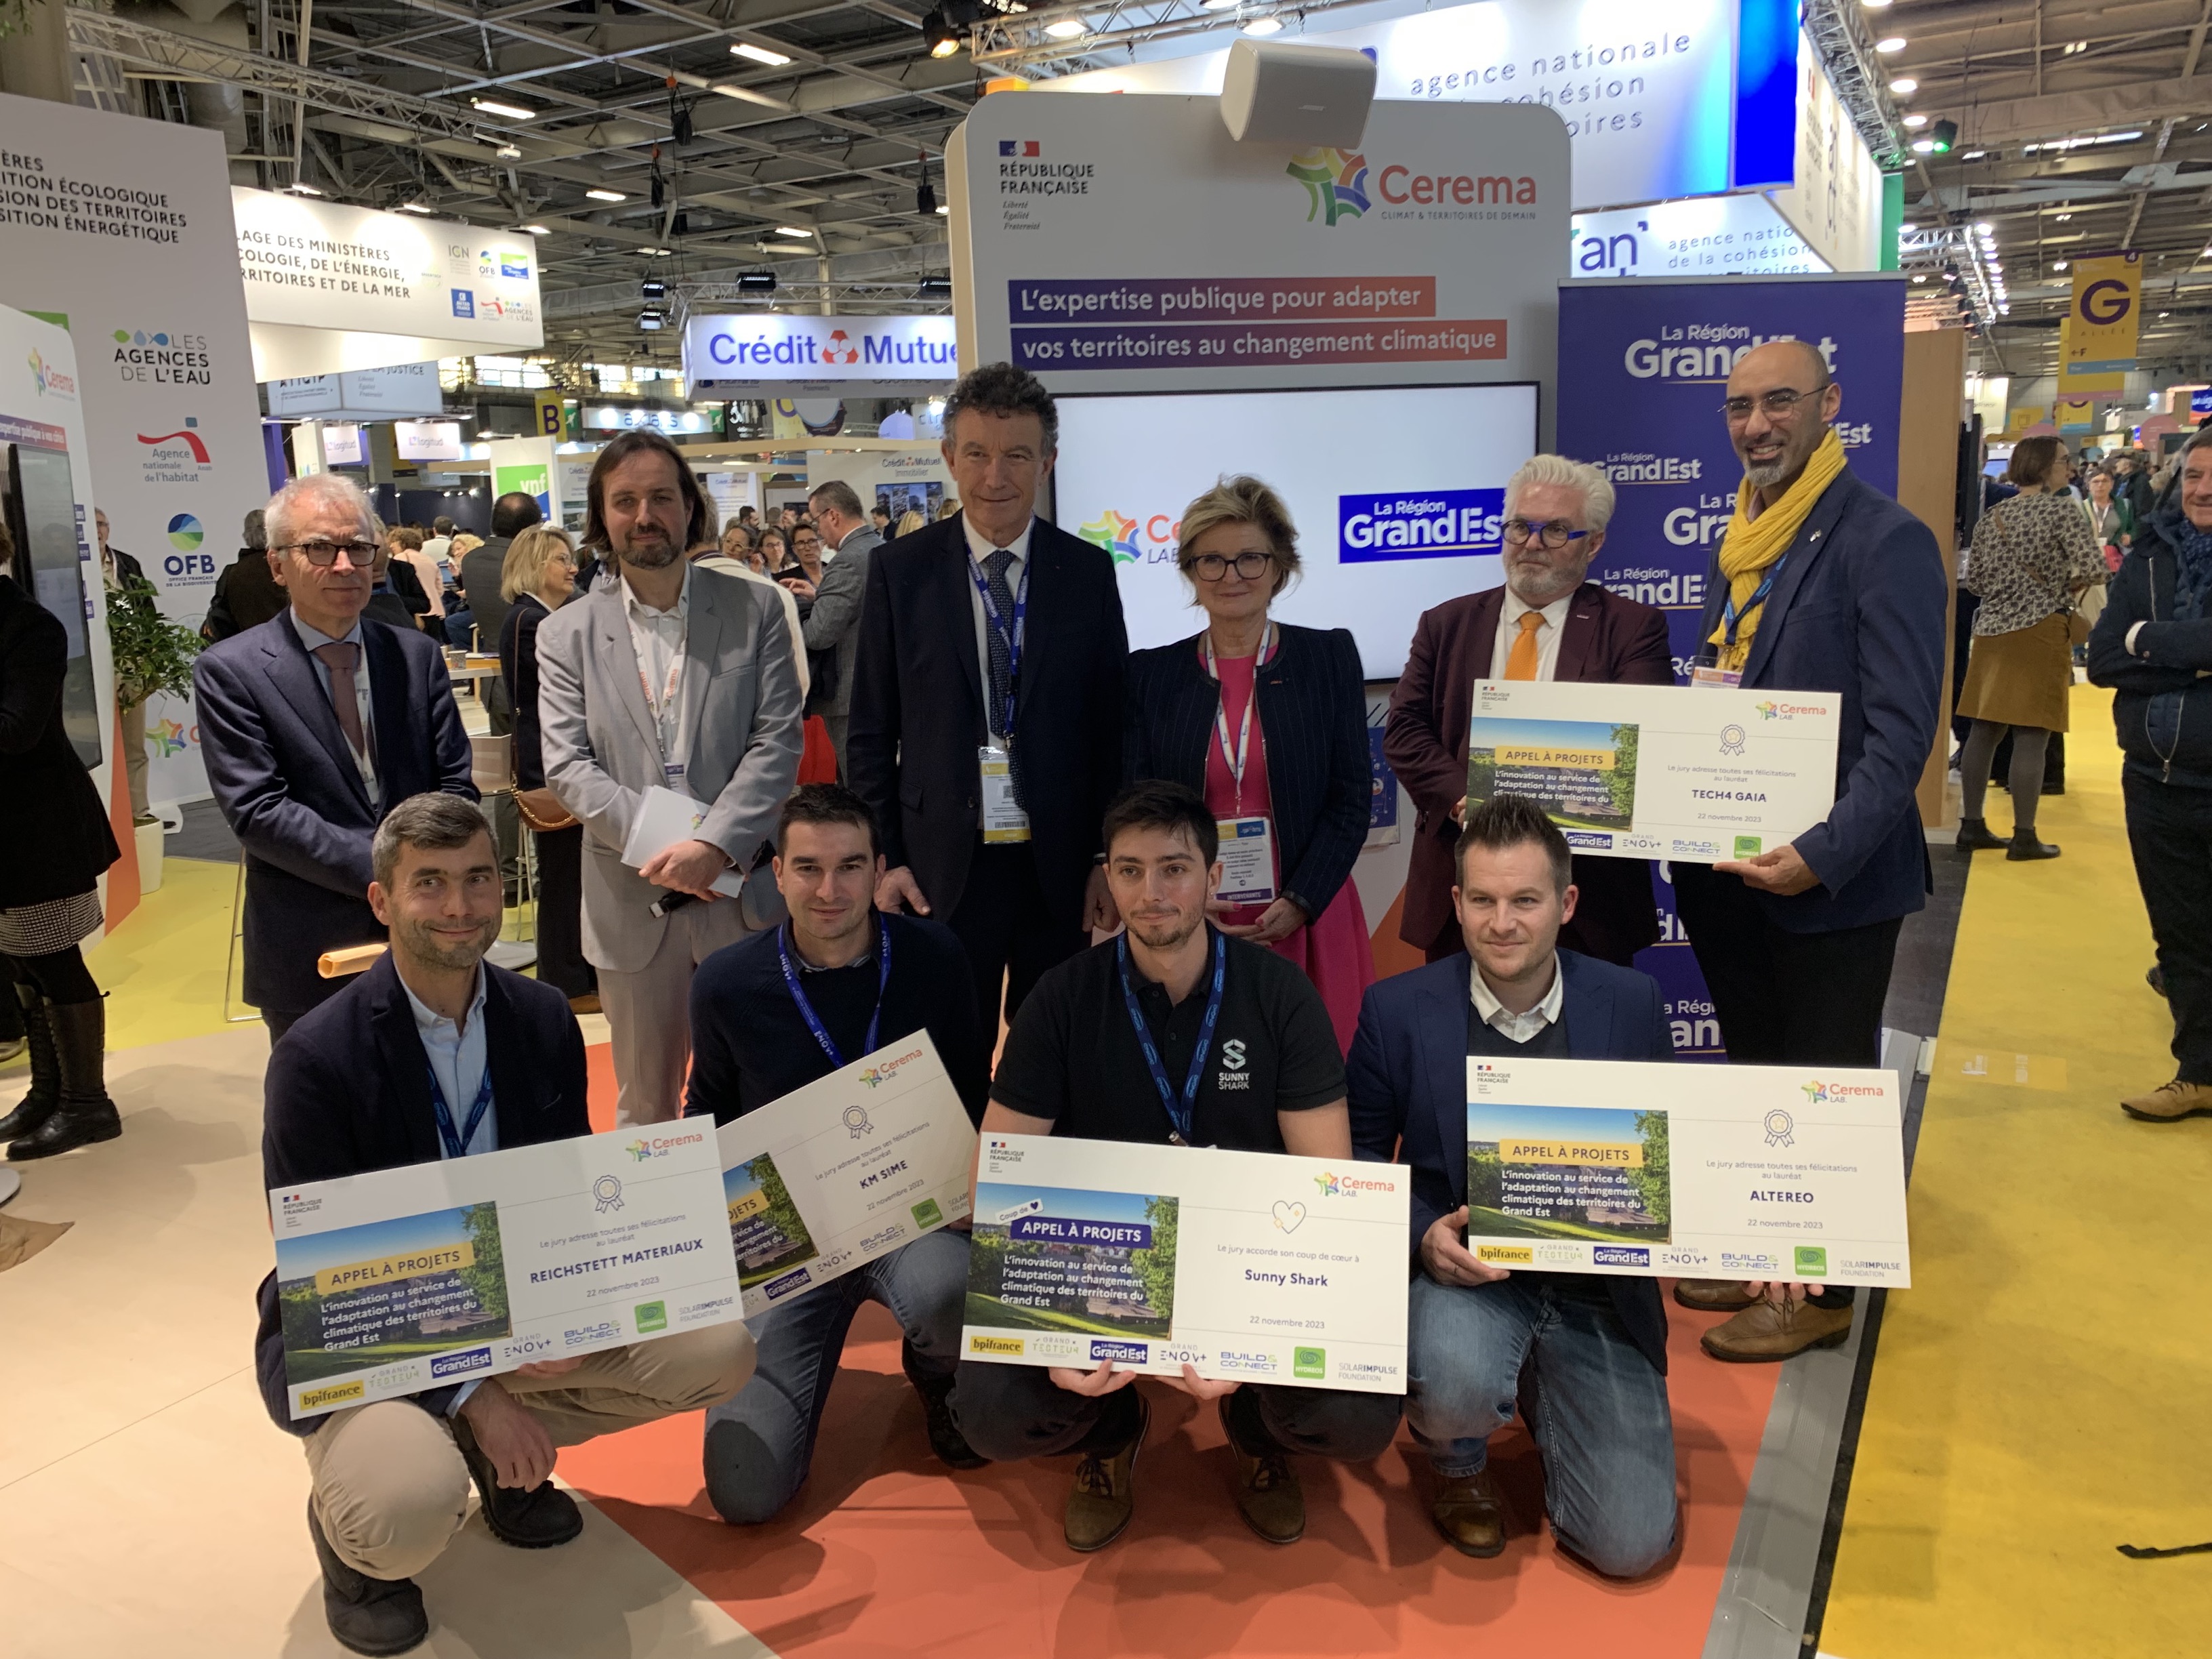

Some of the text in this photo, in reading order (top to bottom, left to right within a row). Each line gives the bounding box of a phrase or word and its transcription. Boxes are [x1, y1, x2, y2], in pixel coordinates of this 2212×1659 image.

[1410, 32, 1691, 100] agence nationale
[1, 149, 44, 171] ÈRES
[1000, 160, 1094, 180] RÉPUBLIQUE
[59, 176, 169, 208] ÉCOLOGIQUE
[1000, 180, 1089, 197] FRANÇAISE
[1379, 165, 1537, 205] Cerema
[47, 196, 79, 213] DES
[83, 201, 187, 228] TERRITOIRES
[1002, 201, 1029, 209] Liberté
[1003, 210, 1029, 221] Égalité
[1381, 211, 1536, 220] CLIMAT & TERRITOIRES DE DEMAIN
[65, 213, 180, 244] ÉNERGÉTIQUE
[1003, 222, 1041, 230] Fraternité
[237, 230, 390, 262] AGE DES MINISTÈRES
[1668, 225, 1795, 253] agence natio
[1668, 243, 1812, 269] de la cohésion
[2128, 251, 2135, 262] 4
[311, 258, 405, 282] DE L'ÉNERGIE,
[479, 266, 495, 274] OFB
[321, 276, 335, 290] ET
[341, 279, 359, 293] DE
[363, 282, 380, 295] LA
[384, 284, 411, 299] MER
[1020, 286, 1421, 316] L'expertise publique pour adapter
[2080, 279, 2130, 325] G
[1662, 323, 1750, 343] La Région
[171, 334, 207, 350] LES
[710, 333, 817, 365] Crédit
[1022, 327, 1497, 359] vos territoires au changement climatique
[114, 348, 209, 368] AGENCES
[2079, 348, 2087, 356] F
[45, 364, 75, 393] Cerema
[121, 366, 211, 385] DE L'EAU
[543, 405, 560, 434] B
[152, 448, 190, 460] Agence
[882, 457, 942, 468] Crédit Mutuel
[1607, 453, 1655, 466] La Région
[142, 461, 182, 470] nationale
[144, 472, 199, 483] de l'habitat
[520, 474, 546, 493] vnf
[1374, 499, 1446, 516] La Région
[1700, 495, 1718, 509] La
[164, 554, 216, 576] OFB
[1604, 567, 1670, 582] La Région
[1780, 703, 1827, 716] Cerema
[1504, 750, 1604, 765] APPEL À PROJETS
[1692, 790, 1767, 802] TECH4 GAIA
[1707, 813, 1743, 822] novembre
[880, 1048, 923, 1073] Cerema
[1218, 1072, 1250, 1081] SUNNY
[1218, 1082, 1249, 1090] SHARK
[1830, 1083, 1884, 1097] Cerema
[653, 1133, 703, 1150] Cerema
[990, 1149, 1025, 1157] RÉPUBLIQUE
[1513, 1145, 1630, 1162] APPEL À PROJETS
[859, 1160, 908, 1189] KM SIME
[1342, 1176, 1395, 1192] Cerema
[1750, 1190, 1814, 1204] ALTEREO
[999, 1206, 1029, 1221] Coup de
[1021, 1222, 1142, 1242] APPEL À PROJETS
[530, 1239, 703, 1284] REICHSTETT MATERIAUX
[1217, 1244, 1227, 1252] Le
[1228, 1245, 1244, 1255] jury
[1246, 1246, 1278, 1256] accorde
[1296, 1251, 1317, 1261] coup
[1319, 1252, 1329, 1261] de
[1331, 1254, 1353, 1263] cœur
[1355, 1254, 1359, 1263] à
[331, 1250, 460, 1286] APPEL À PROJETS
[1004, 1255, 1133, 1274] L'innovation au service de
[1003, 1267, 1143, 1288] l'adaptation au changement
[1245, 1269, 1328, 1287] Sunny Shark
[1002, 1282, 1143, 1301] climatique des territoires du
[1000, 1294, 1050, 1307] Grand Est
[1250, 1315, 1325, 1330] 22 novembre 2023
[973, 1338, 1021, 1353] bpifrance
[1295, 1366, 1323, 1375] HYDREOS
[1338, 1372, 1382, 1382] FOUNDATION
